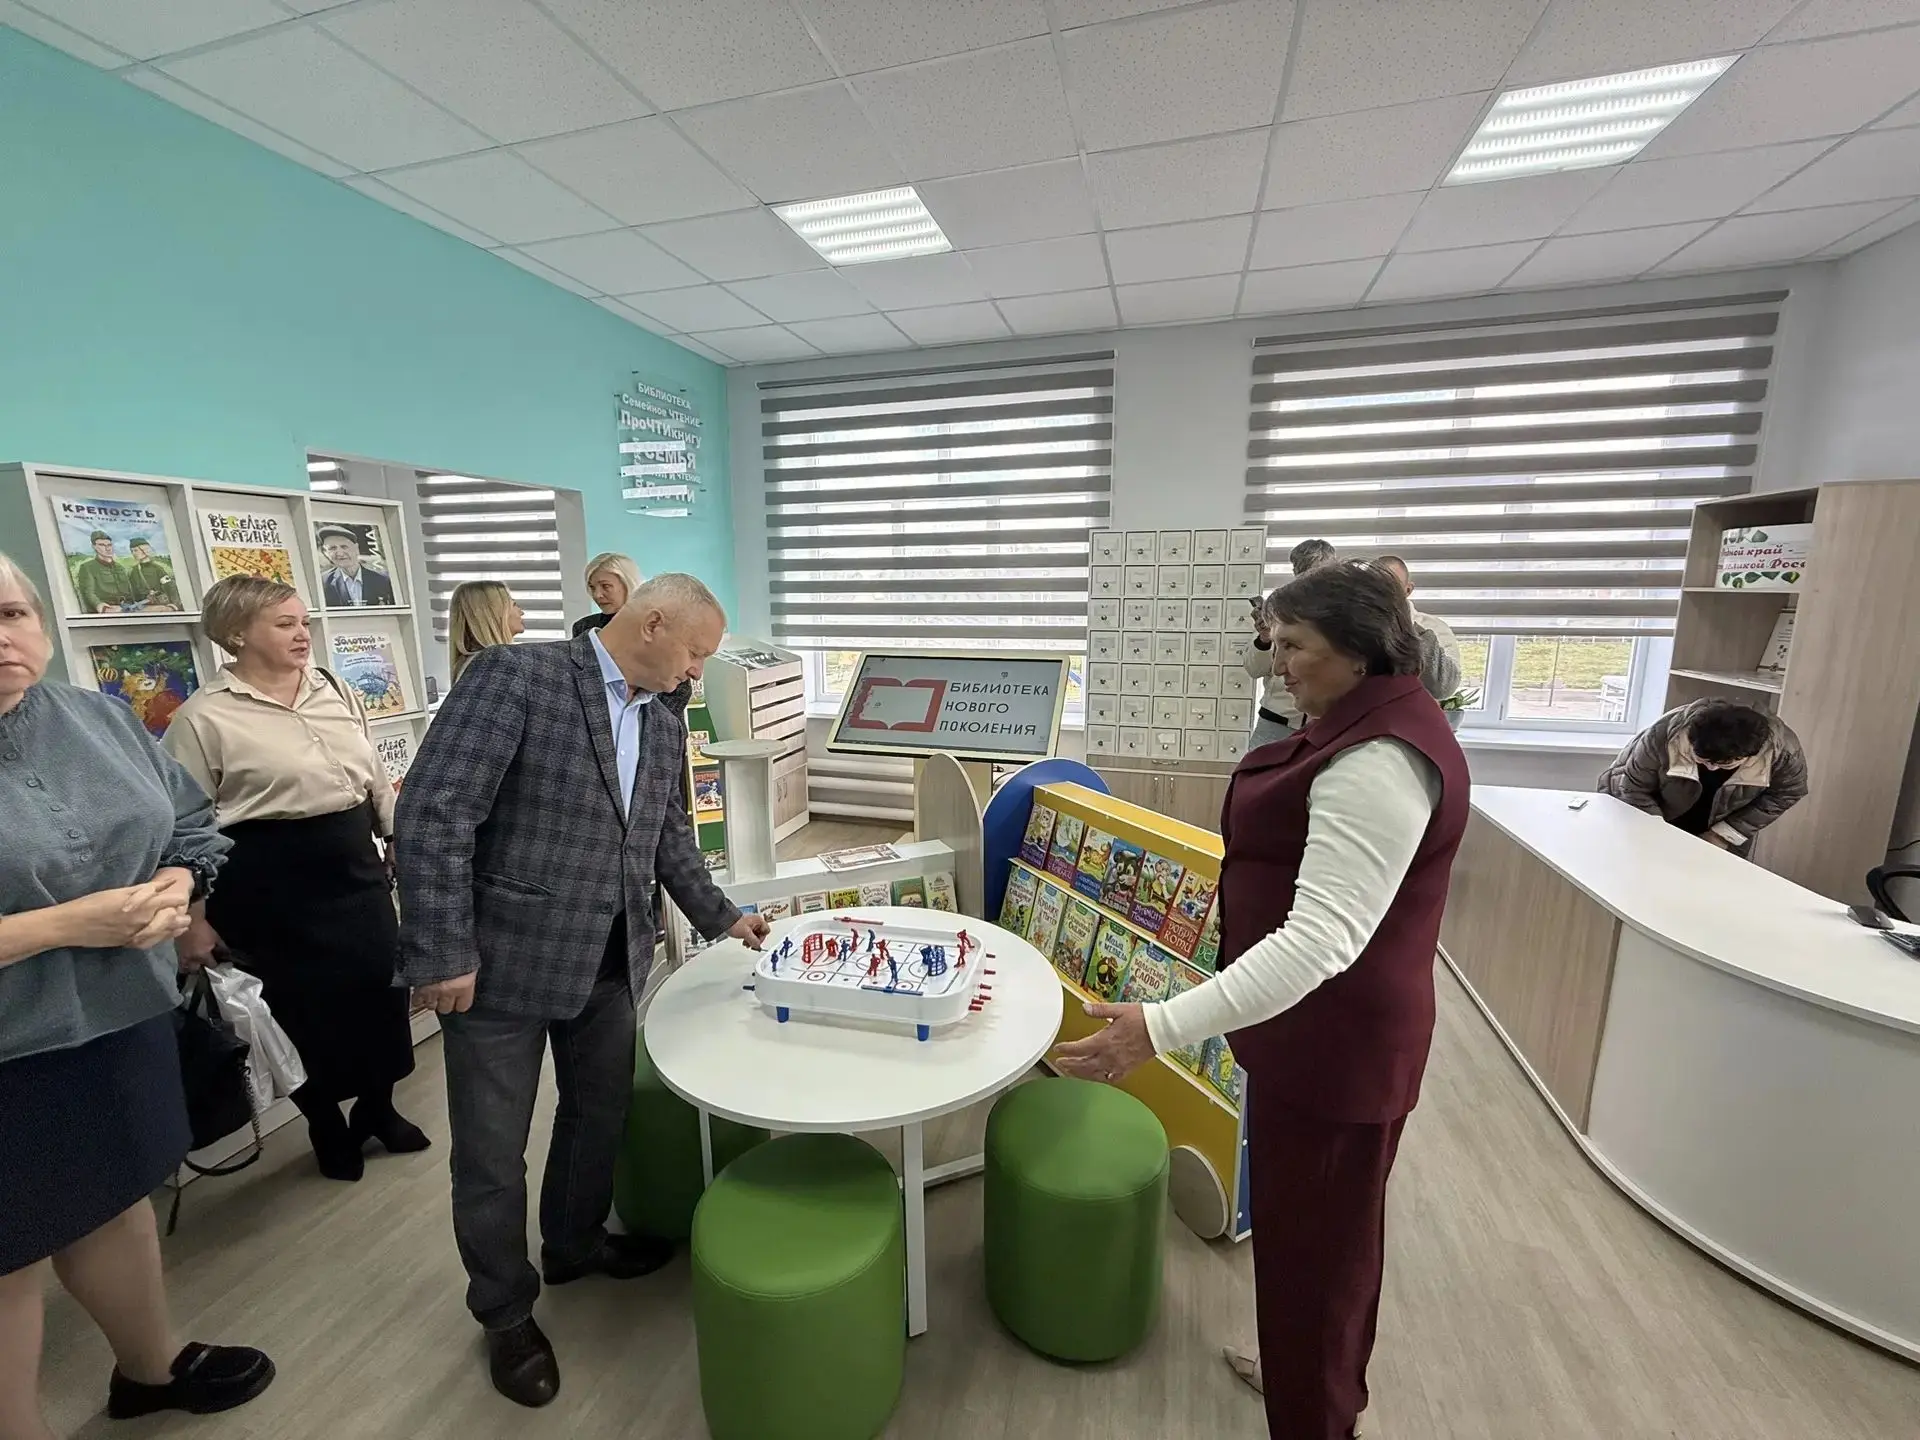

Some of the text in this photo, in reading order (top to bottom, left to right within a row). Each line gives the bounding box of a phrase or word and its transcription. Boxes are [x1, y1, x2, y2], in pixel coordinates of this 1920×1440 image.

[62, 503, 155, 518] КРЕПОСТЬ
[1747, 545, 1783, 557] край
[334, 635, 376, 646] ЗОЛОТОЙ
[950, 682, 1049, 696] БИБЛИОТЕКА
[944, 701, 1009, 714] НОВОГО
[939, 720, 1036, 736] ПОКОЛЕНИЯ
[1134, 967, 1160, 990] СЛОВО
